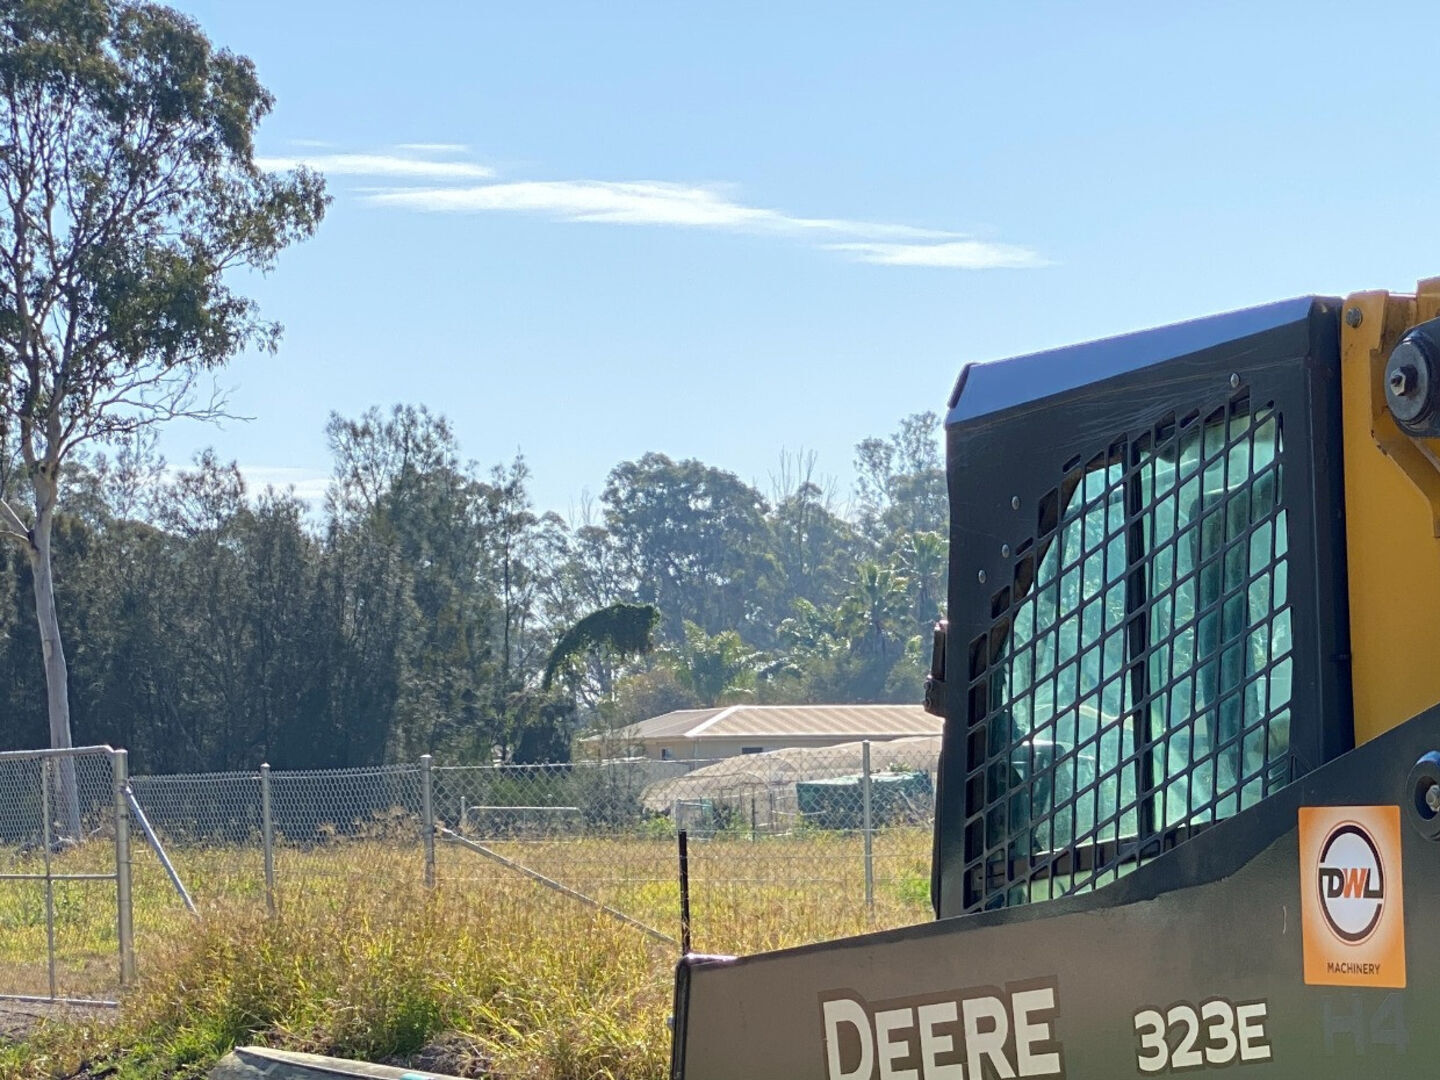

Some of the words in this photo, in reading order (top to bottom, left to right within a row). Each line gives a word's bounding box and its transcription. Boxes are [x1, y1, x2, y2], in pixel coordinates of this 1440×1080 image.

[1319, 867, 1384, 899] DWL
[1327, 962, 1381, 976] MACHINERY
[1134, 999, 1271, 1073] 323E
[1320, 992, 1410, 1057] H4
